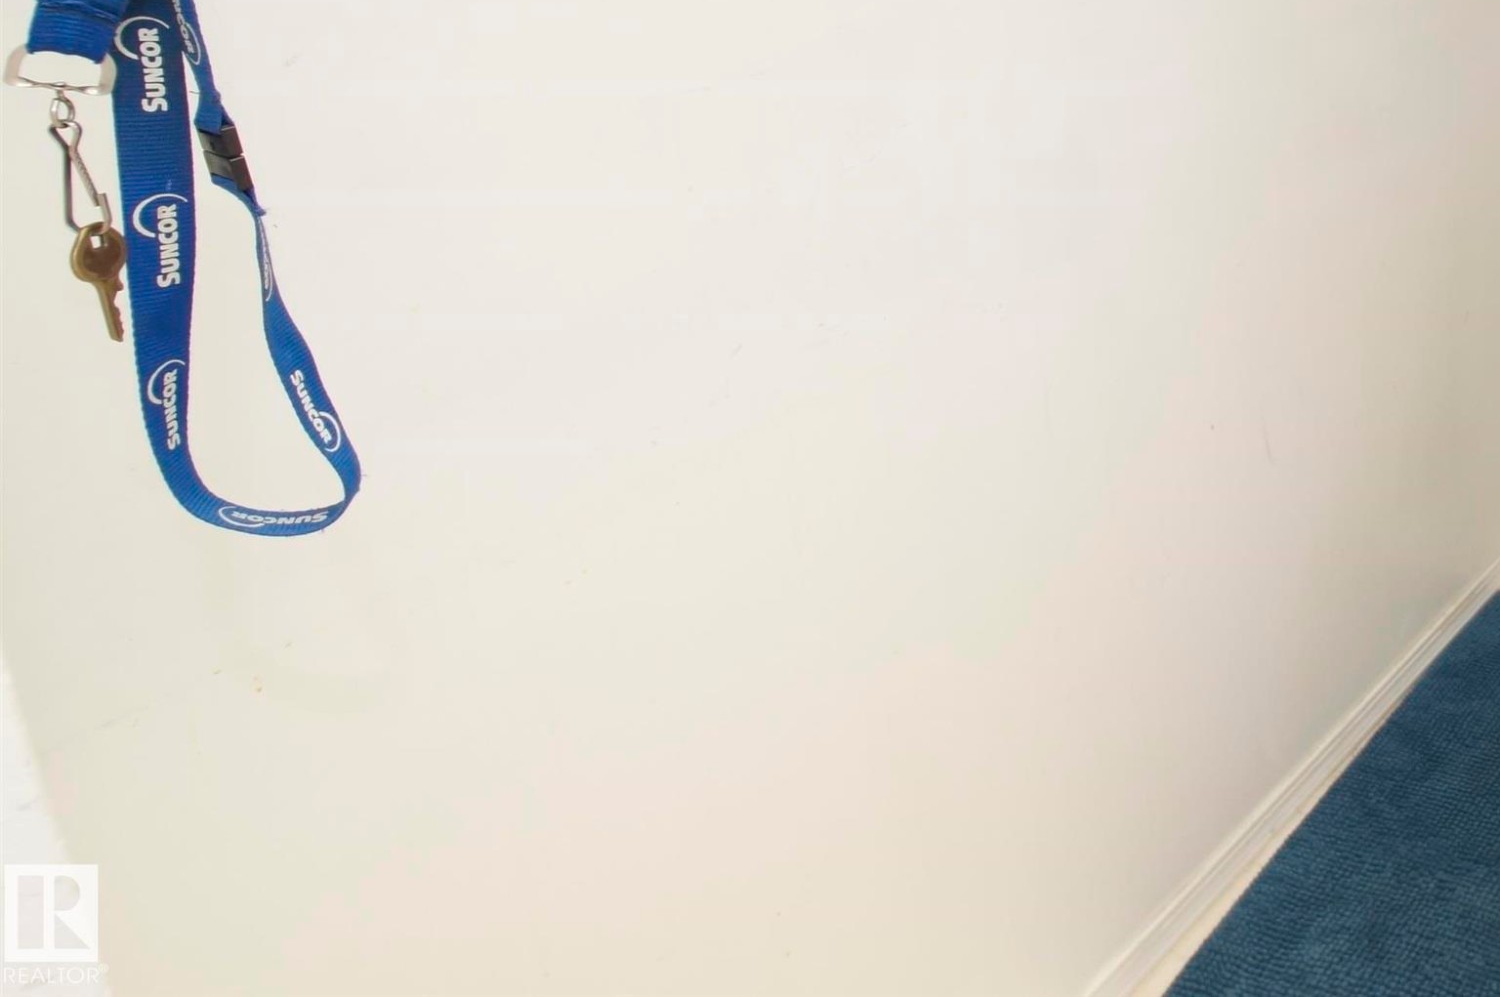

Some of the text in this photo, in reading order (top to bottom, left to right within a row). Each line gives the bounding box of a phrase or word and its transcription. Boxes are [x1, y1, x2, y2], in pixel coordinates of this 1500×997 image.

[137, 27, 169, 113] SUNCOR
[156, 203, 182, 289] SUNCOR
[162, 368, 181, 451] SUNCOR
[290, 369, 332, 444] SUNCOR
[231, 511, 329, 525] SUNCOR
